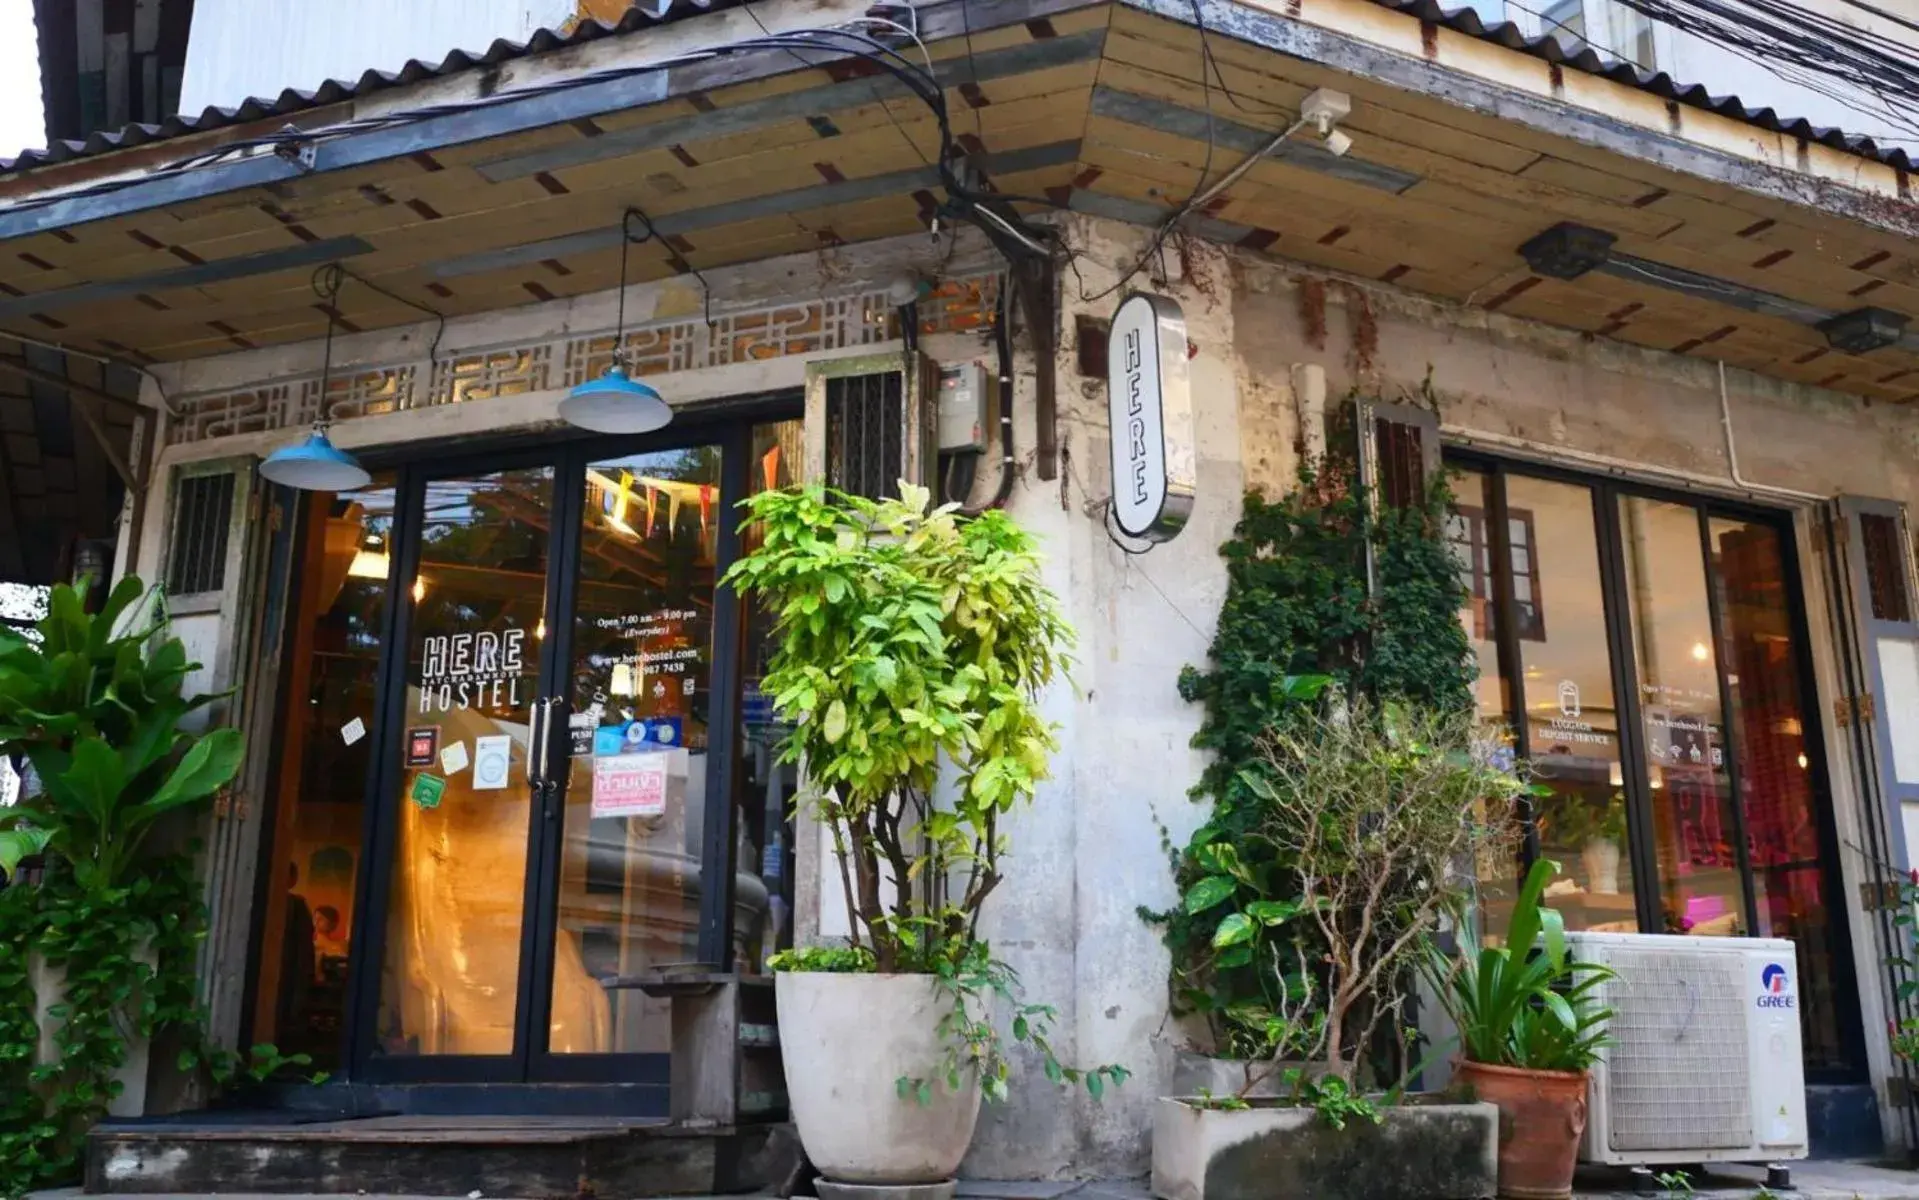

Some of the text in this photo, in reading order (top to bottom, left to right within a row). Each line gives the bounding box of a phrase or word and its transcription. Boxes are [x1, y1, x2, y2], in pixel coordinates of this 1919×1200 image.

[1124, 327, 1148, 506] HERE
[597, 618, 618, 629] Open
[422, 629, 524, 677] HERE
[420, 678, 520, 713] HOSTEL
[1757, 995, 1794, 1008] GREE
